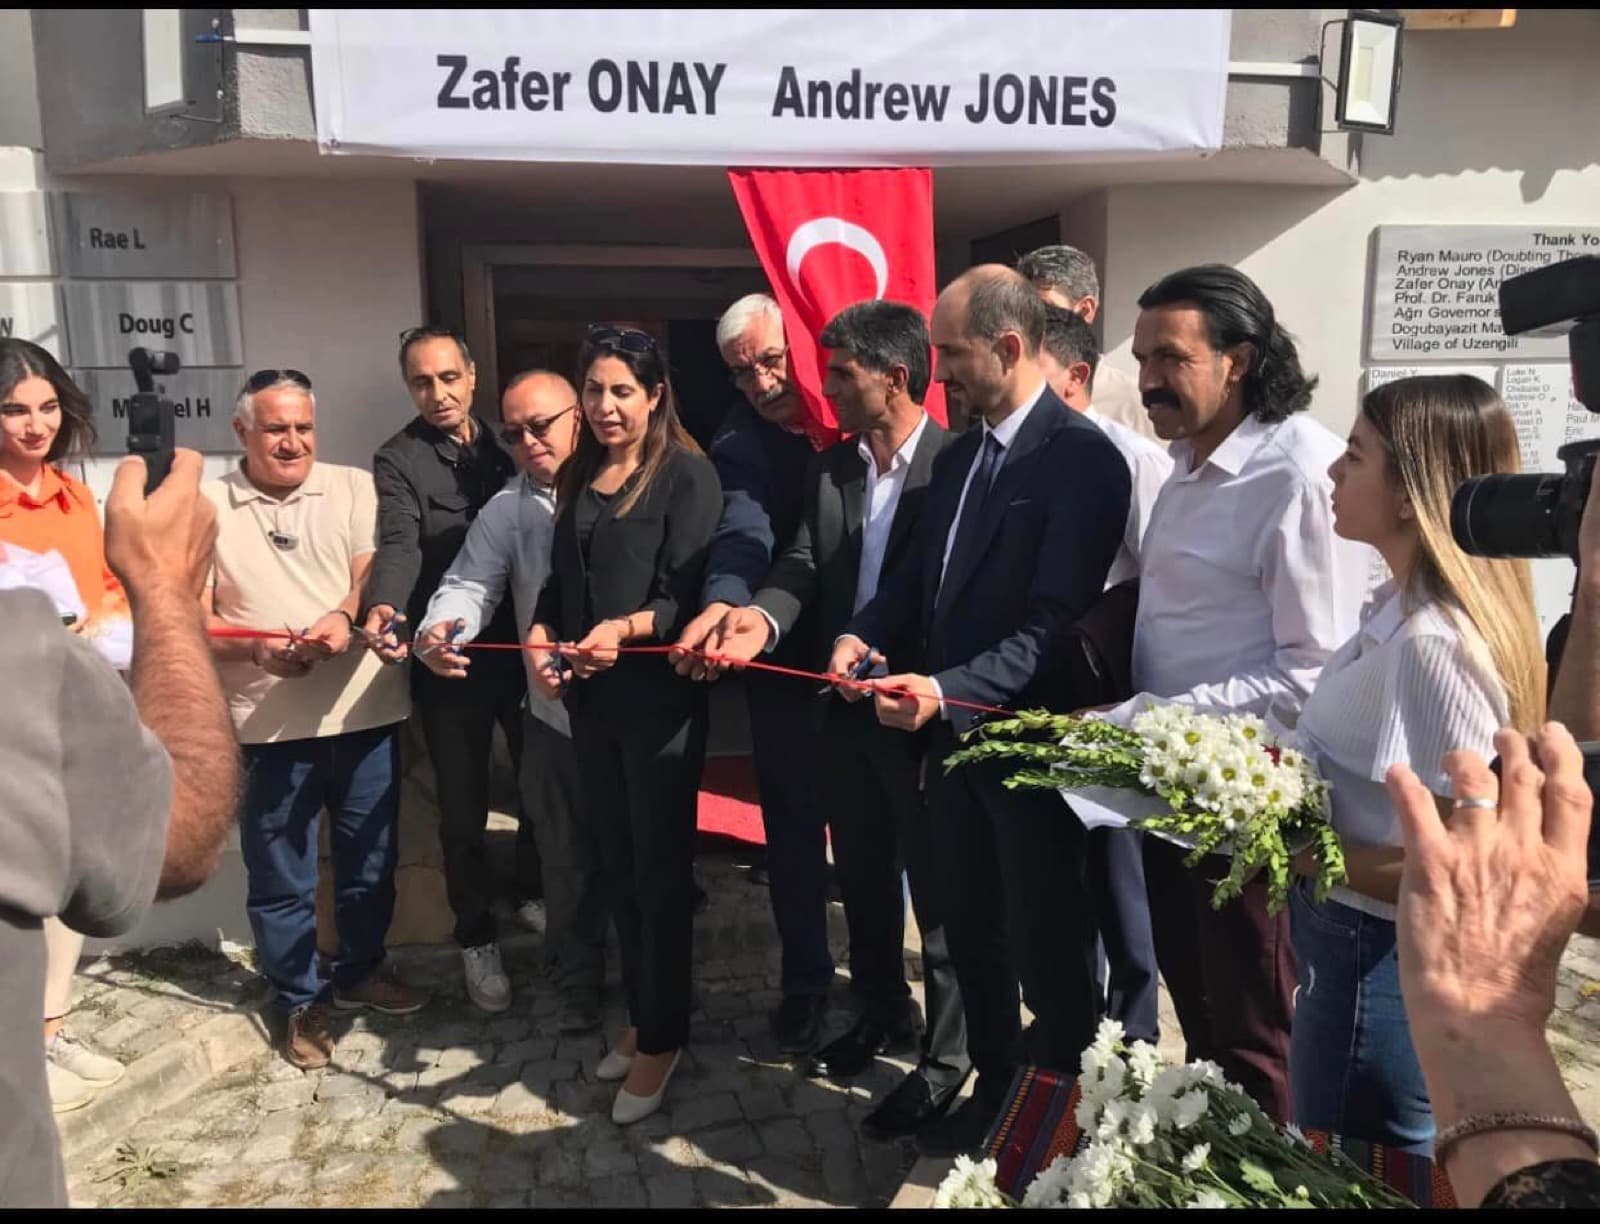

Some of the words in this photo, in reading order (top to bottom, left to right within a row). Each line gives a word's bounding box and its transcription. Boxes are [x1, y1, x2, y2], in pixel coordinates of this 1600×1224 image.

[436, 55, 571, 112] Zafer
[588, 59, 726, 115] ONAY
[772, 66, 949, 122] Andrew
[965, 73, 1117, 127] JONES
[89, 227, 129, 248] Rae
[134, 228, 146, 249] L
[1533, 233, 1575, 246] Thank
[1397, 250, 1435, 264] Ryan
[1438, 249, 1482, 262] Mauro
[1486, 249, 1551, 264] (Doubting
[1396, 265, 1449, 277] Andrew
[1453, 264, 1495, 276] Jones
[1395, 278, 1432, 290] Zafer
[1437, 278, 1474, 291] Onay
[1394, 292, 1425, 304] Prof.
[1432, 292, 1451, 304] Dr.
[1456, 291, 1495, 304] Faruk
[119, 313, 175, 339] Doug
[179, 314, 194, 334] C
[1392, 339, 1440, 352] Village
[1444, 338, 1458, 350] of
[1463, 338, 1518, 352] Uzengili
[197, 398, 211, 418] H
